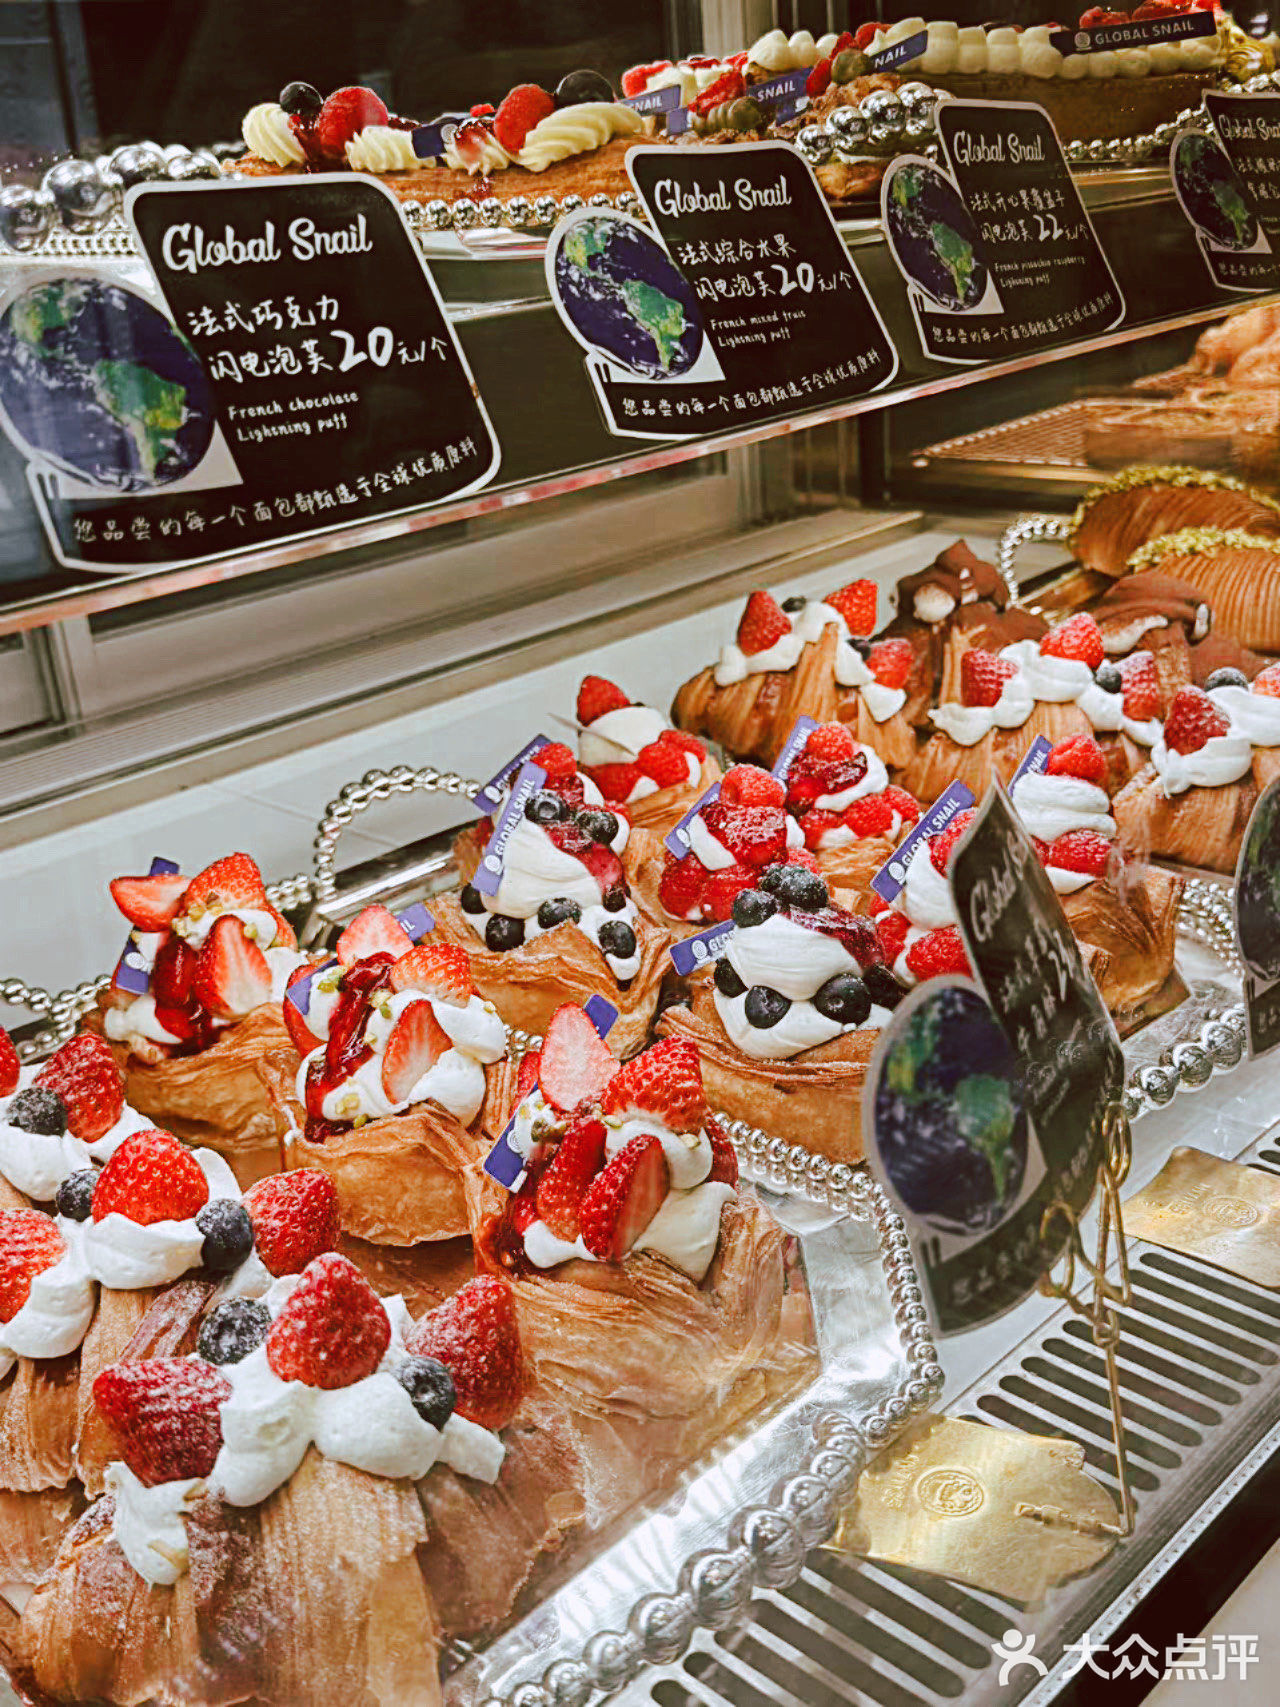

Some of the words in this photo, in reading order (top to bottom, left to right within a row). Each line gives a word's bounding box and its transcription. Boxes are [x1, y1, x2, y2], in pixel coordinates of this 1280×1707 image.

[1095, 28, 1149, 45] GLOBAL
[1152, 20, 1195, 37] SNAIL
[871, 45, 907, 69] NAIL
[757, 79, 796, 103] SNAIL
[953, 130, 1006, 167] Global
[1008, 134, 1046, 164] Snail
[653, 178, 731, 218] Global
[734, 175, 793, 212] Snail
[161, 221, 282, 275] Global
[287, 214, 374, 262] Snail
[677, 233, 797, 265] 法式综合水果
[186, 294, 340, 337] 法式巧克力
[710, 316, 747, 331] French
[750, 310, 779, 325] mixed
[782, 309, 807, 323] fruit
[770, 327, 791, 342] puff
[227, 400, 283, 421] French
[289, 391, 360, 412] chocolate
[236, 420, 312, 443] Lightning
[317, 412, 348, 433] puff
[513, 778, 536, 811] SNAIL
[932, 798, 961, 830] SNAIL
